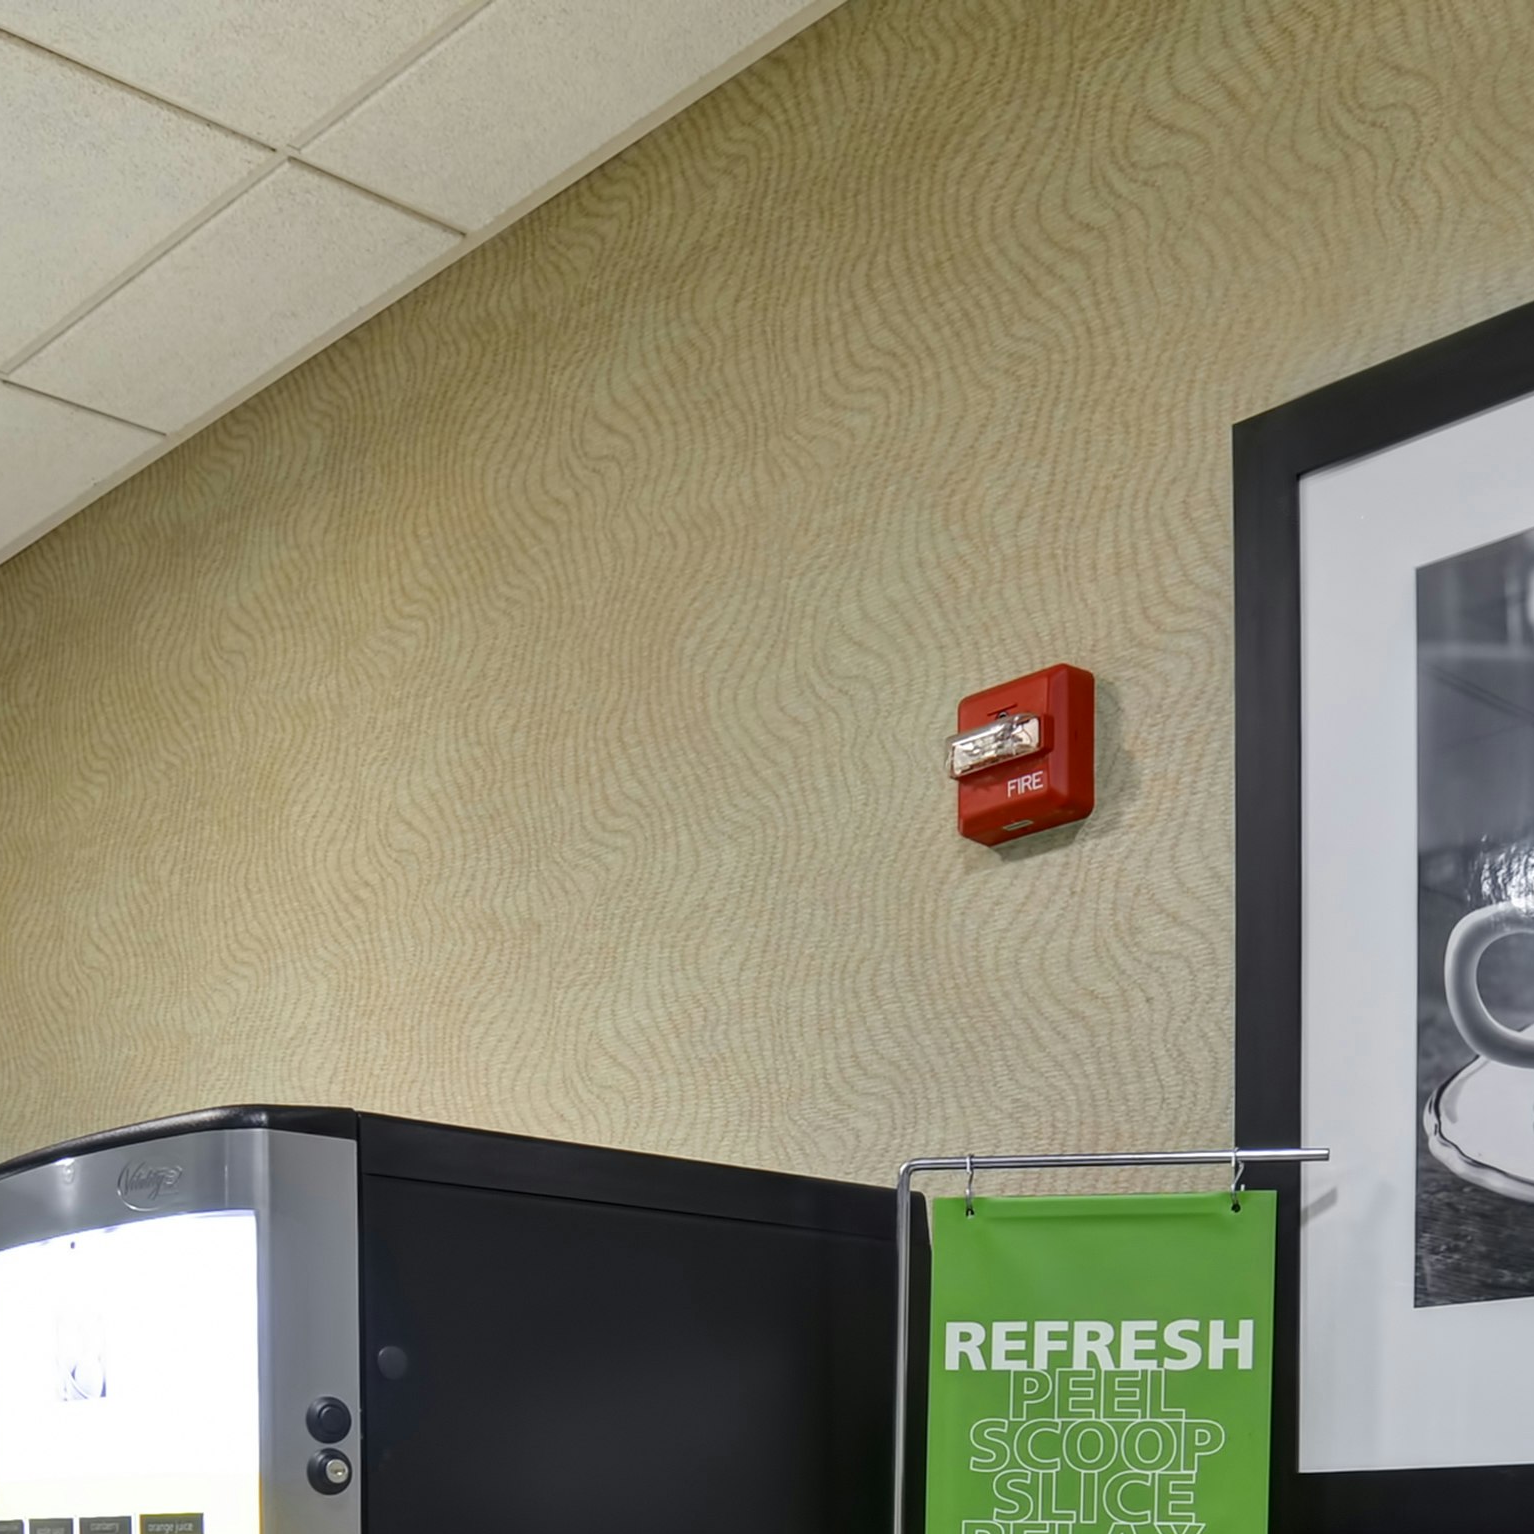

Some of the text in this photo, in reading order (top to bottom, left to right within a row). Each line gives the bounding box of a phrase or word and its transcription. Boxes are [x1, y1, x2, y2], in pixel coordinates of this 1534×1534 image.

[1007, 771, 1044, 798] FIRE
[944, 1319, 1255, 1371] REFRESH
[1009, 1367, 1186, 1421] PEEL
[969, 1417, 1226, 1473] SCOOP
[992, 1468, 1197, 1525] SLICE
